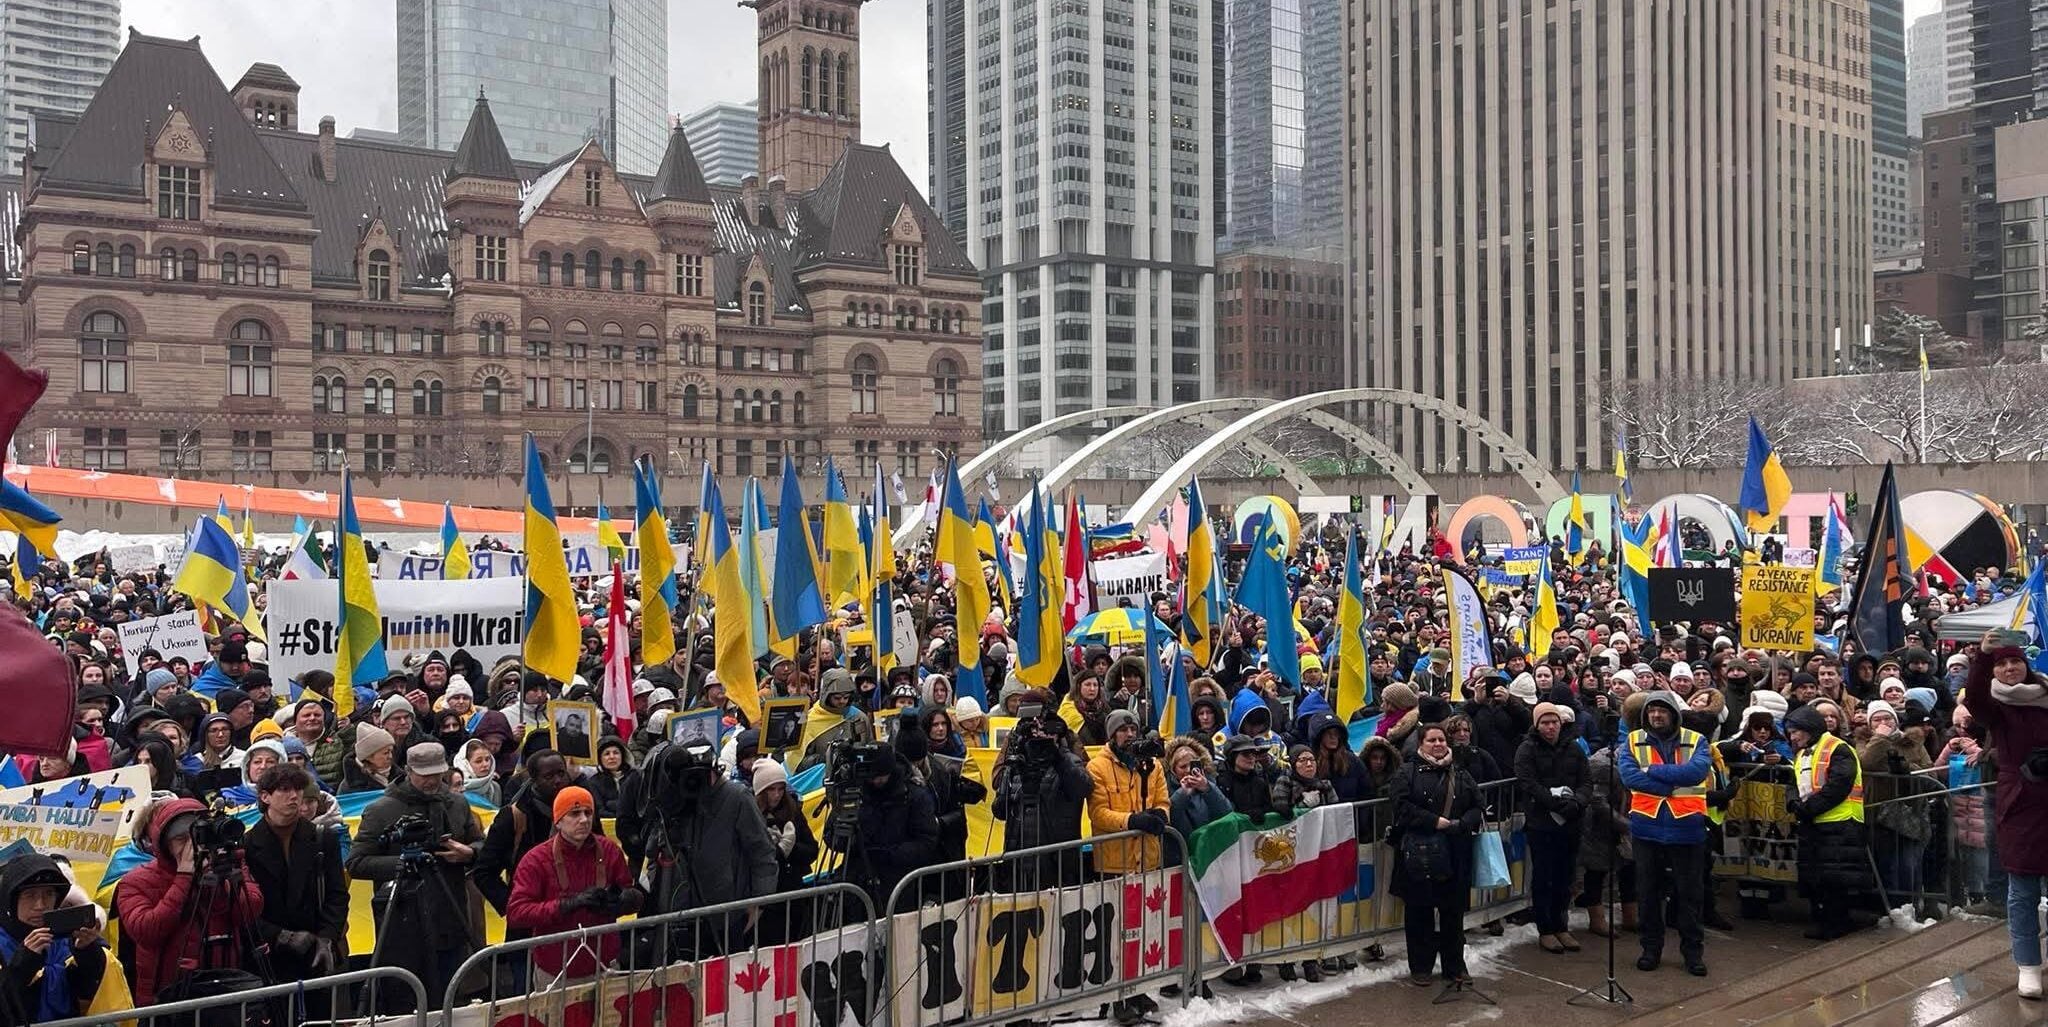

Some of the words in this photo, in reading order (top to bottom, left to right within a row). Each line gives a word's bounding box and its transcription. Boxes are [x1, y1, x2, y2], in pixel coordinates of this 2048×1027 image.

[398, 552, 492, 580] АРЯ
[1757, 569, 1765, 578] 4
[1767, 570, 1797, 580] YEARS
[1801, 573, 1810, 581] OF
[1749, 579, 1809, 593] RESISTANCE
[122, 624, 160, 637] Iranians
[167, 613, 196, 630] stand
[162, 639, 198, 650] Ukraine
[1750, 629, 1804, 645] UKRAINE
